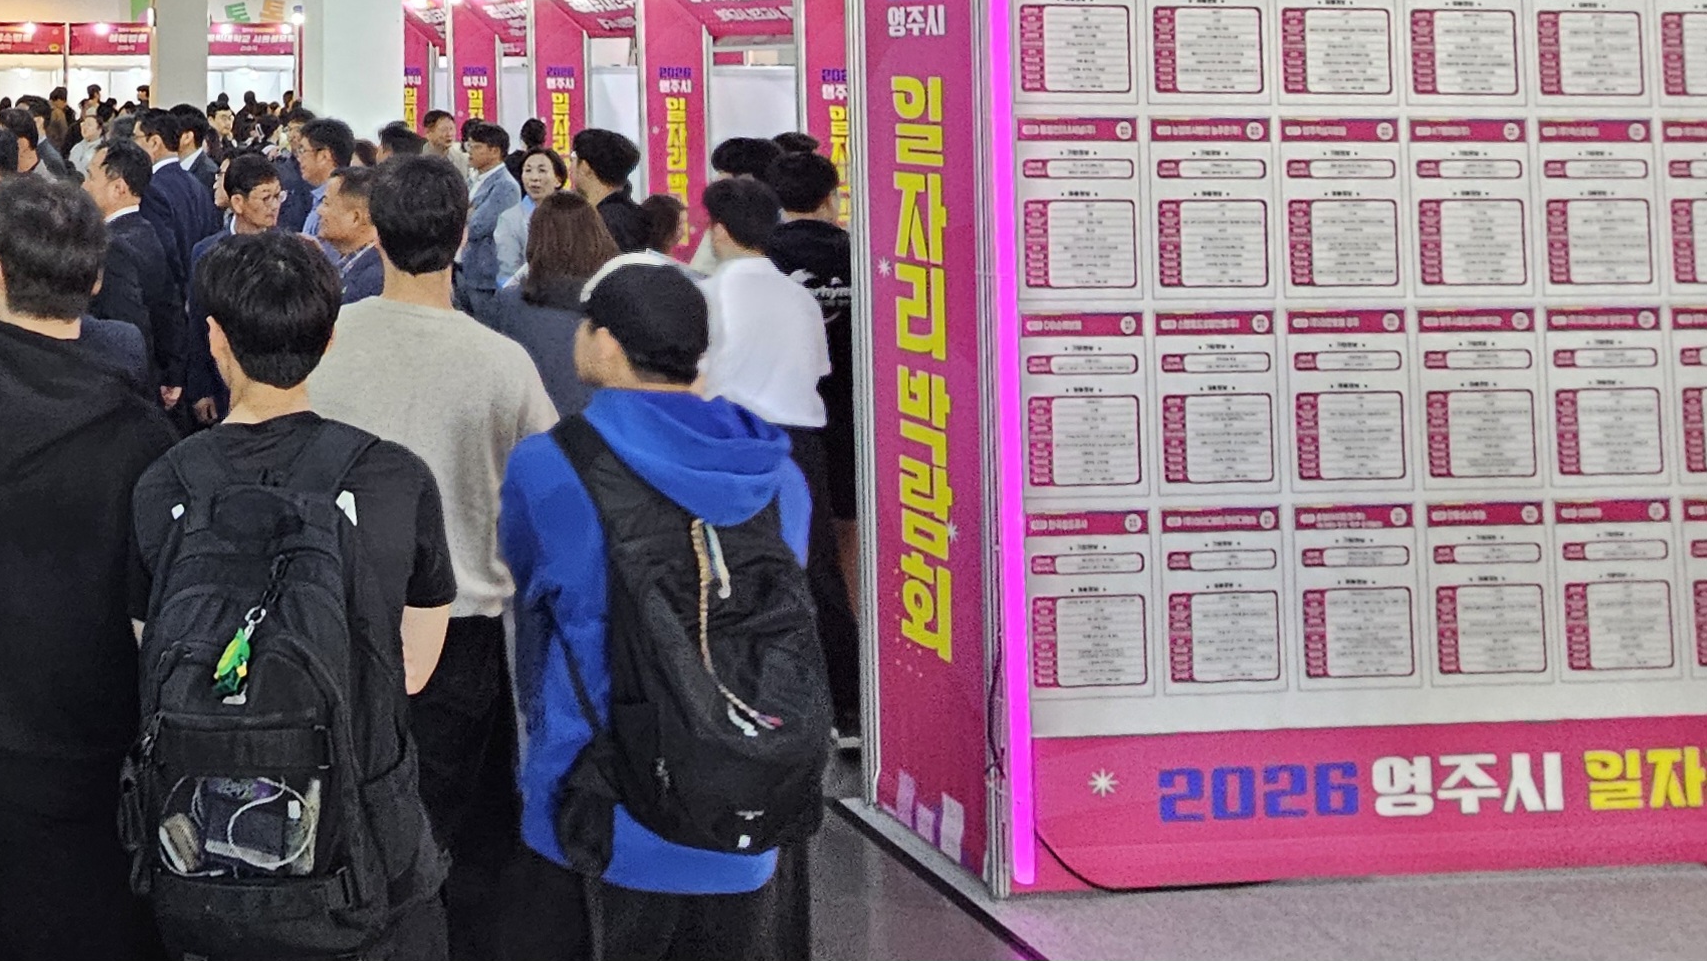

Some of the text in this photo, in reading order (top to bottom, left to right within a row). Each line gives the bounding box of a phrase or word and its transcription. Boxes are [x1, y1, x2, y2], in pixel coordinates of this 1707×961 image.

[887, 4, 946, 37] 영주시
[659, 66, 691, 79] 2026
[659, 79, 692, 94] 영주시
[665, 96, 688, 171] 일자리
[891, 75, 953, 664] 일자리 박람회
[1157, 760, 1360, 824] 2026
[1371, 751, 1566, 818] 영주시
